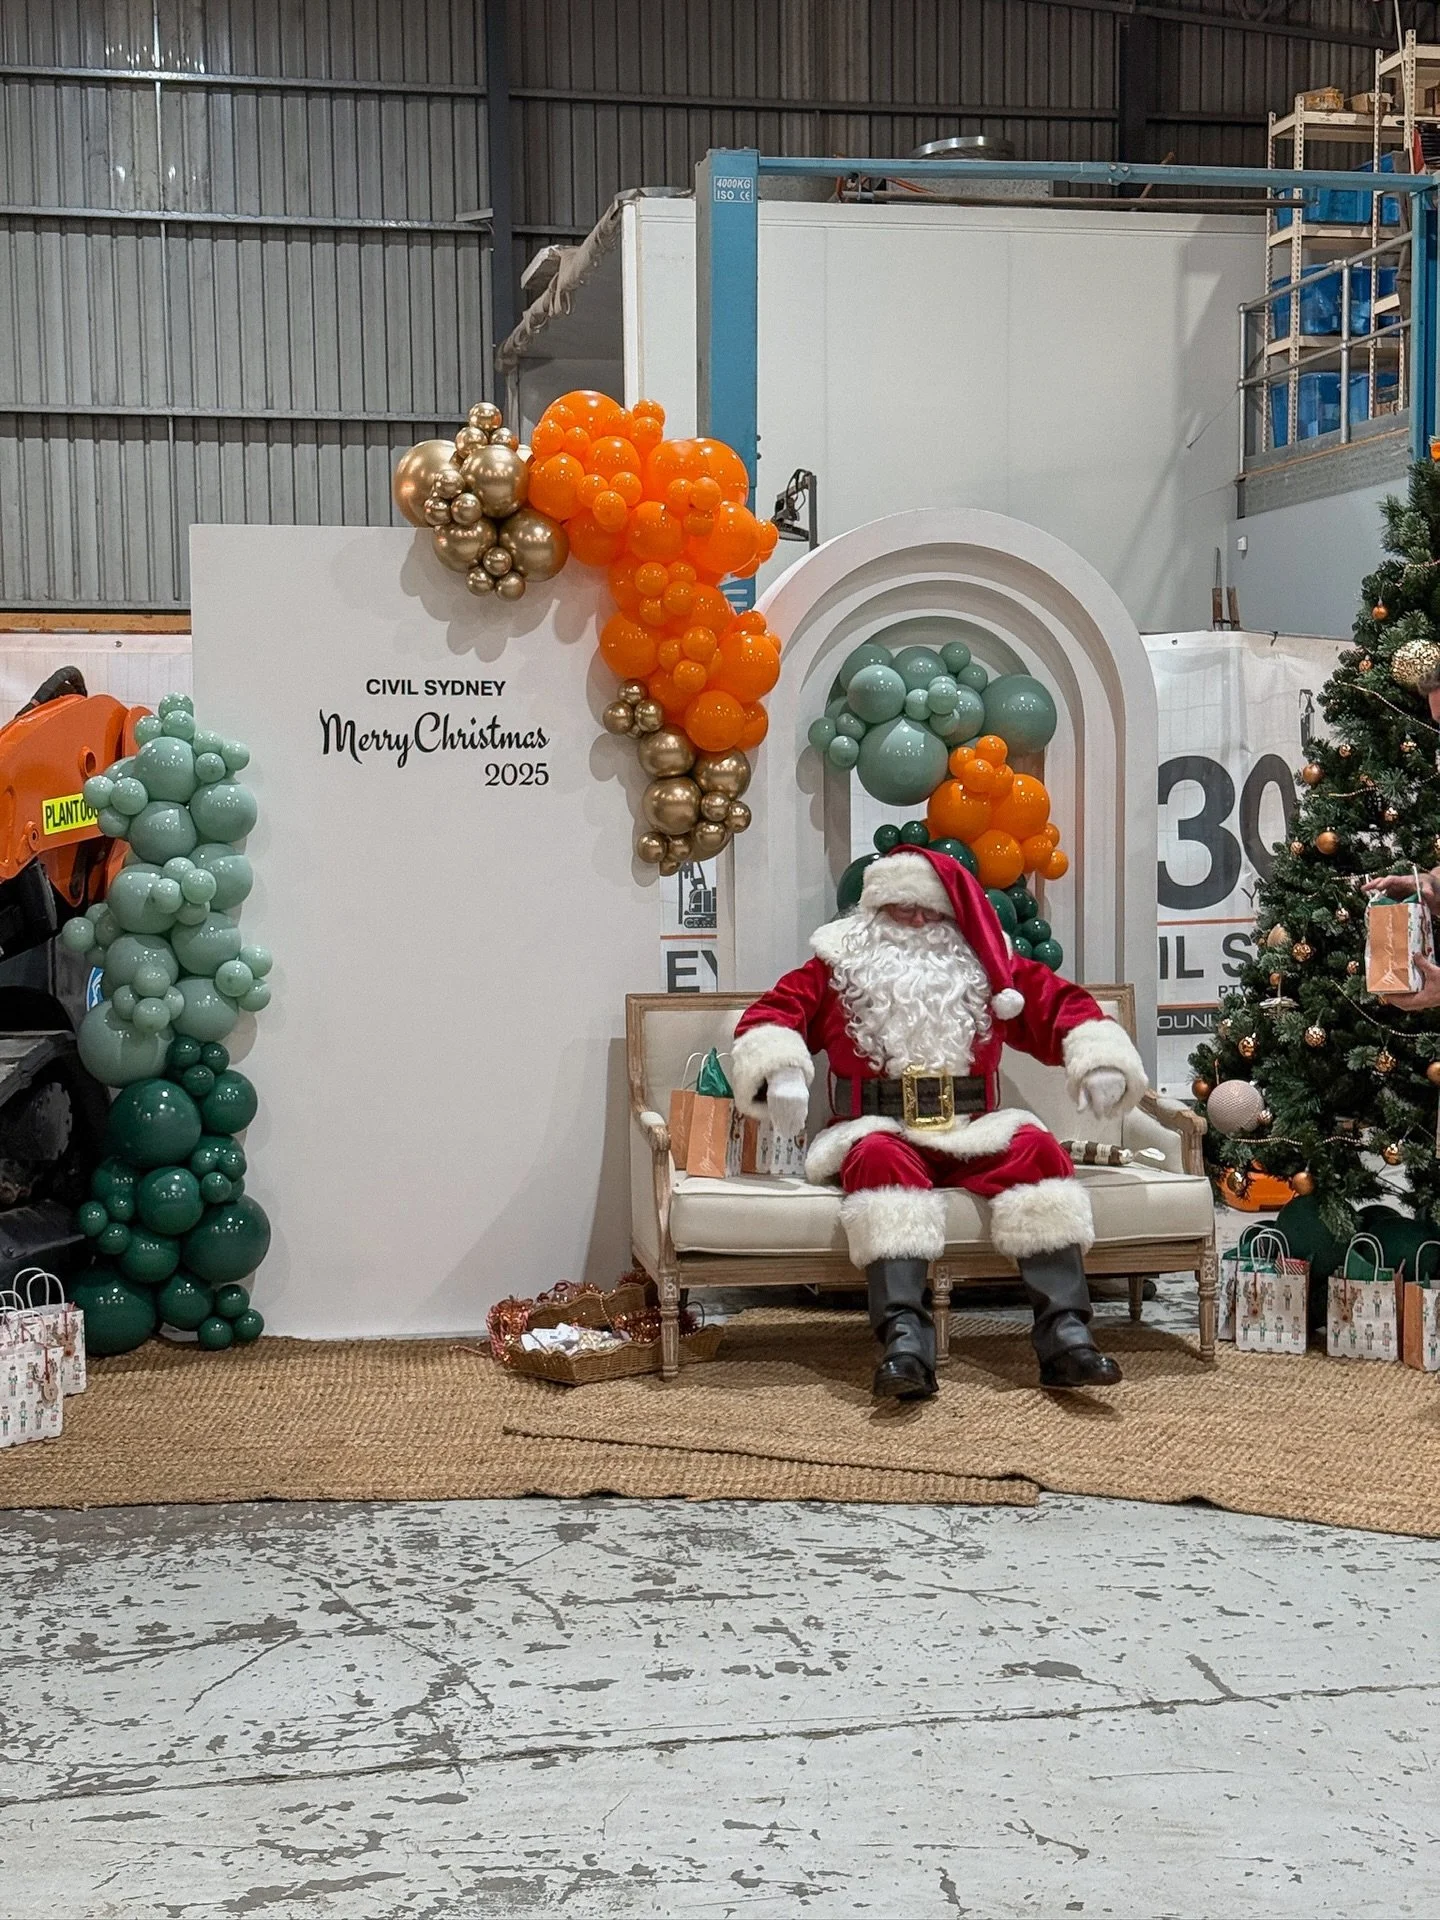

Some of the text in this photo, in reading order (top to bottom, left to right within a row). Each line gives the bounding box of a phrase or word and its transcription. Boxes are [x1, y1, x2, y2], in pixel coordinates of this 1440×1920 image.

[716, 178, 751, 189] 4000KG
[717, 190, 735, 200] ISO
[366, 678, 506, 696] CIVIL SYDNEY
[319, 709, 551, 769] Merry Christmas
[485, 762, 550, 787] 2025
[1157, 753, 1300, 910] 30
